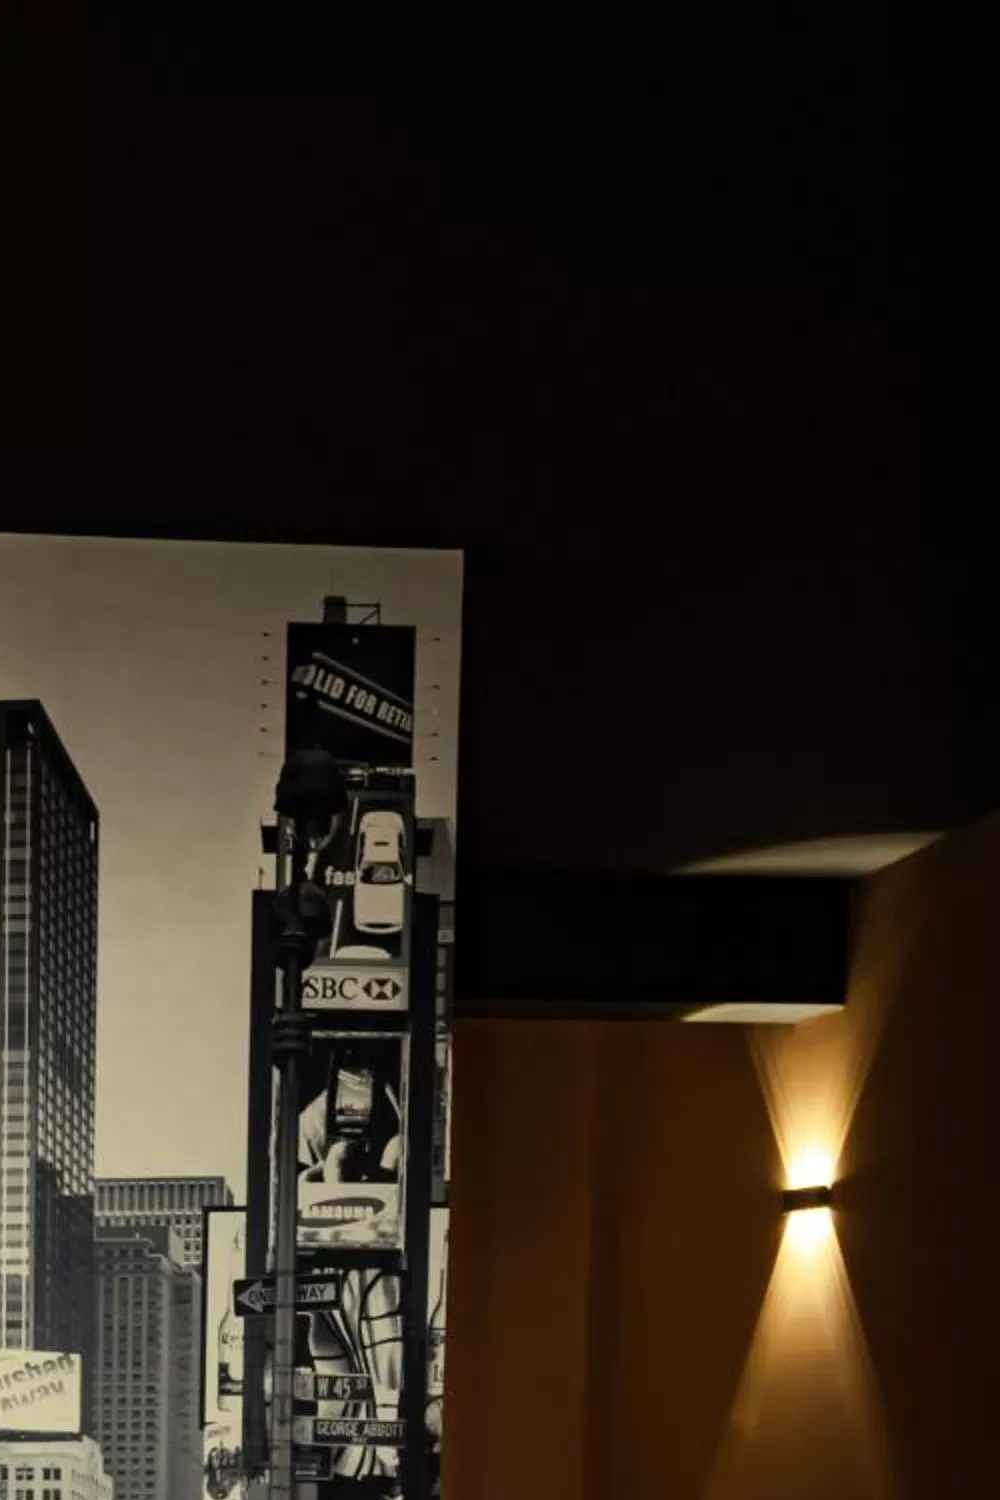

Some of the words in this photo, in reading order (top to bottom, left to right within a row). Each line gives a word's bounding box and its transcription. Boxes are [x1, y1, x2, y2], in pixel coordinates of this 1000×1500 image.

[303, 976, 359, 1000] SBC
[333, 1377, 352, 1399] 45
[315, 1421, 361, 1437] GEORGE
[362, 1421, 404, 1437] ABBOTT
